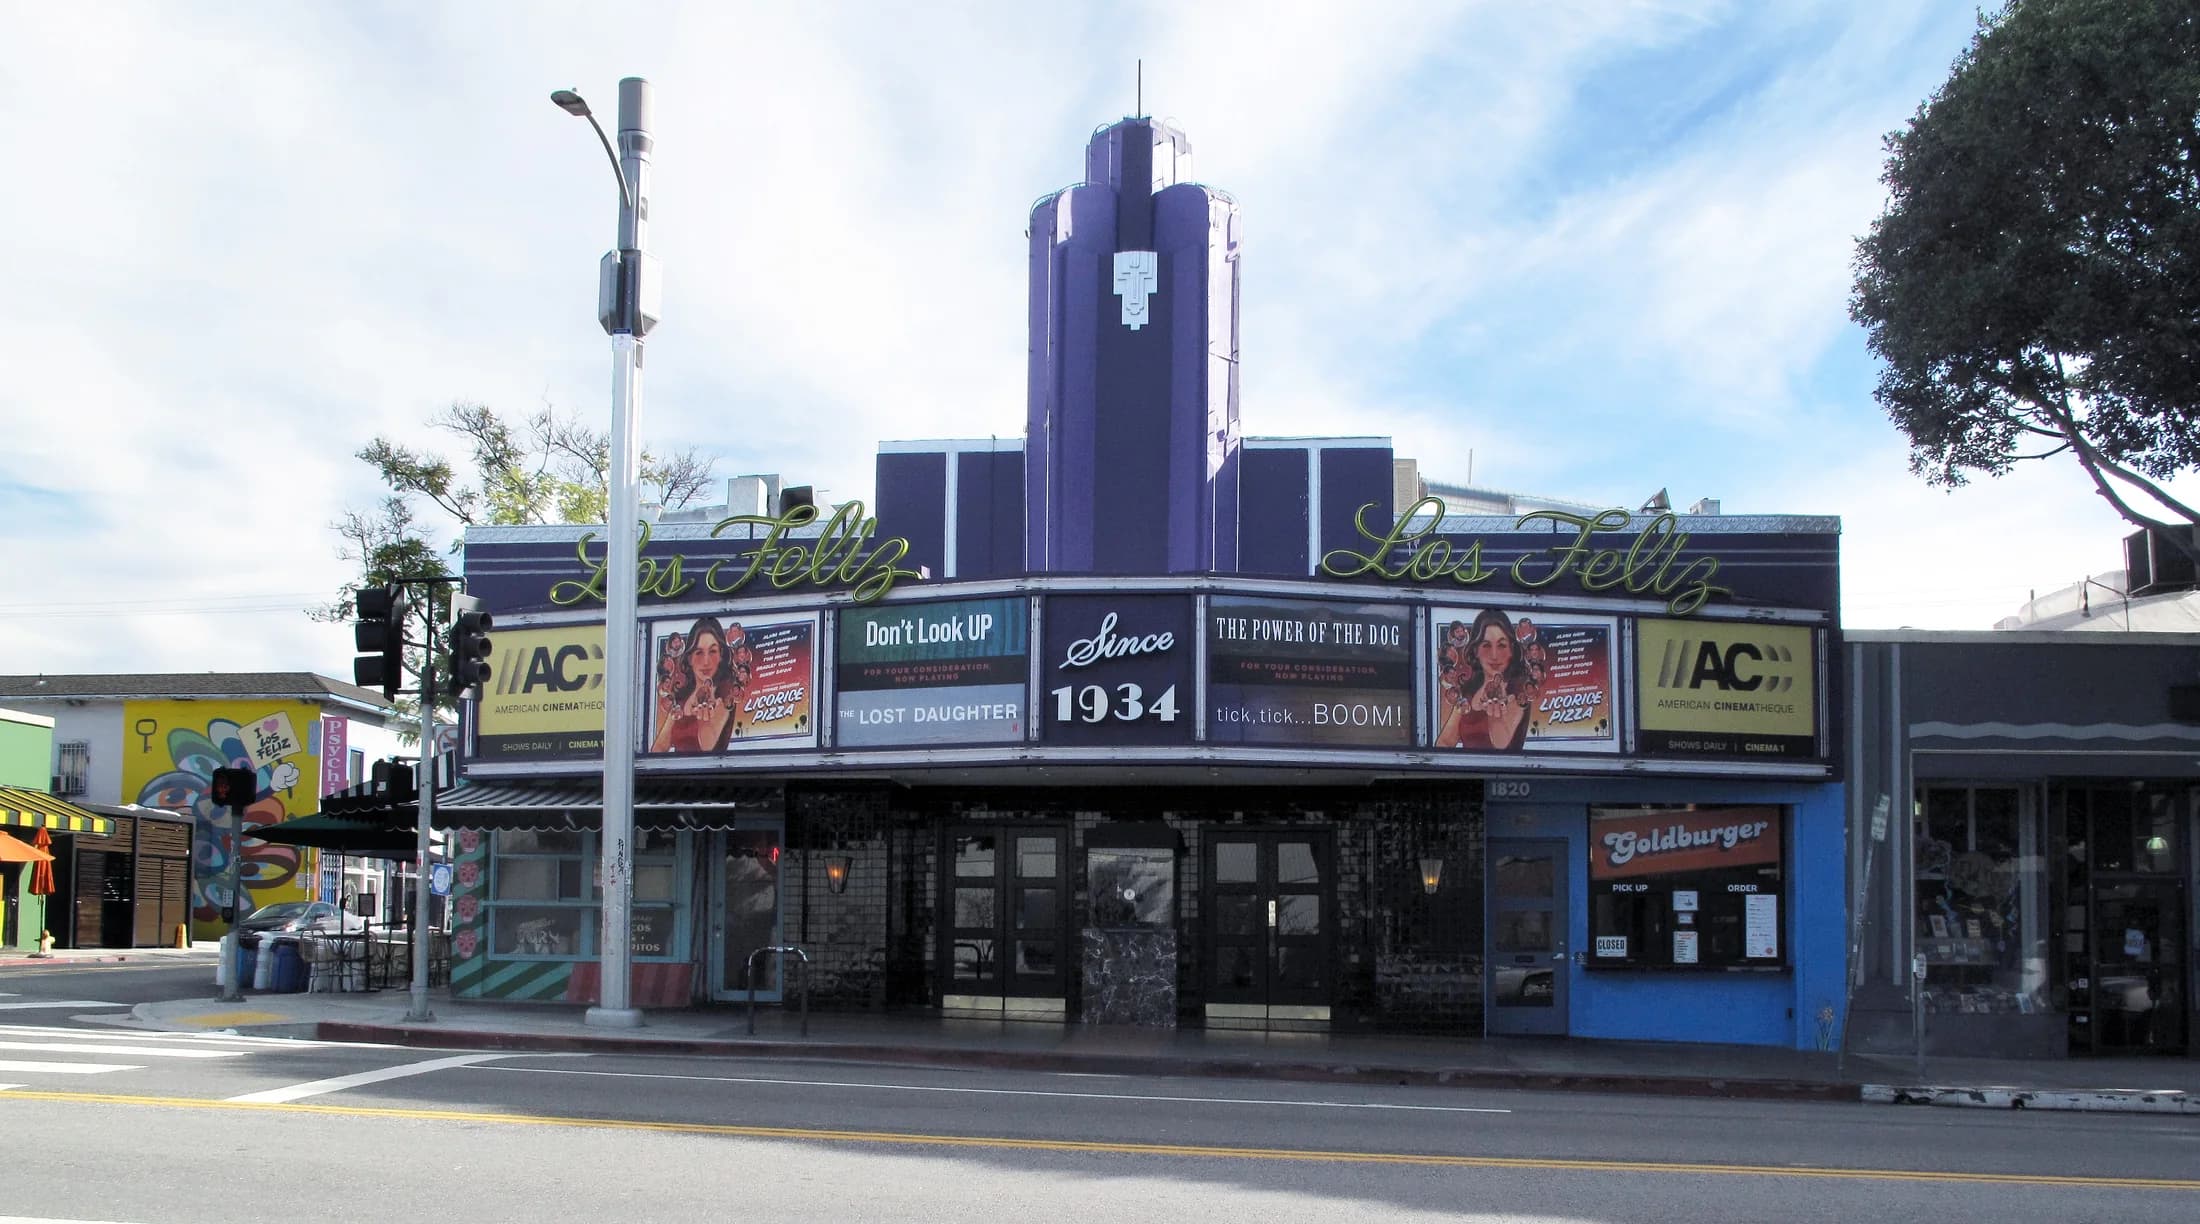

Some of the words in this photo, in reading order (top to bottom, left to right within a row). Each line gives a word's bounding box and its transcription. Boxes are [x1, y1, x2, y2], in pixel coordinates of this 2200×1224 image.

[706, 500, 921, 602] Feliz
[1321, 496, 1497, 585] Los
[1511, 508, 1730, 616] Feliz
[866, 619, 913, 647] Don't
[918, 615, 963, 644] Look
[968, 614, 992, 641] UP
[1216, 617, 1247, 640] THE
[1252, 618, 1303, 642] POWER
[1309, 621, 1327, 643] OF
[1333, 622, 1363, 645] THE
[1369, 624, 1400, 646] DOG
[1058, 611, 1174, 669] Since
[864, 668, 881, 676] FOR
[1240, 662, 1260, 670] FOR
[1265, 663, 1290, 671] YOUR
[895, 675, 914, 683] NOW
[920, 673, 959, 682] PLAYING
[1301, 673, 1343, 681] PLAYING
[496, 703, 540, 714] AMERICAN
[542, 700, 605, 712] CINEMATHEQ
[744, 687, 804, 712] LICORICE
[1051, 682, 1180, 723] 1934
[1539, 691, 1603, 712] LICORICE
[1657, 699, 1710, 710] AMERICAN
[1714, 701, 1795, 714] CINEMATHEQUE
[752, 703, 795, 724] PIZZA
[840, 710, 854, 718] THE
[859, 708, 906, 725] LOST
[914, 704, 1017, 723] DAUGHTER
[1314, 703, 1401, 727] BOOM!
[1548, 706, 1593, 724] PIZZA
[254, 727, 262, 739] I
[260, 732, 280, 747] LOS
[256, 738, 291, 760] FELIZ
[502, 743, 530, 751] SHOWS
[532, 742, 552, 751] DAILY
[569, 740, 598, 749] CINEMA
[1668, 740, 1700, 750] SHOWS
[1703, 743, 1727, 751] DAILY
[1744, 743, 1778, 752] CINEMA
[327, 720, 342, 795] Psychi
[1491, 782, 1530, 796] 1820
[1604, 821, 1768, 865] Goldburger
[1612, 884, 1632, 892] PICK
[1635, 884, 1648, 892] UP
[1728, 884, 1758, 893] ORDER
[1597, 939, 1625, 950] CLOSED
